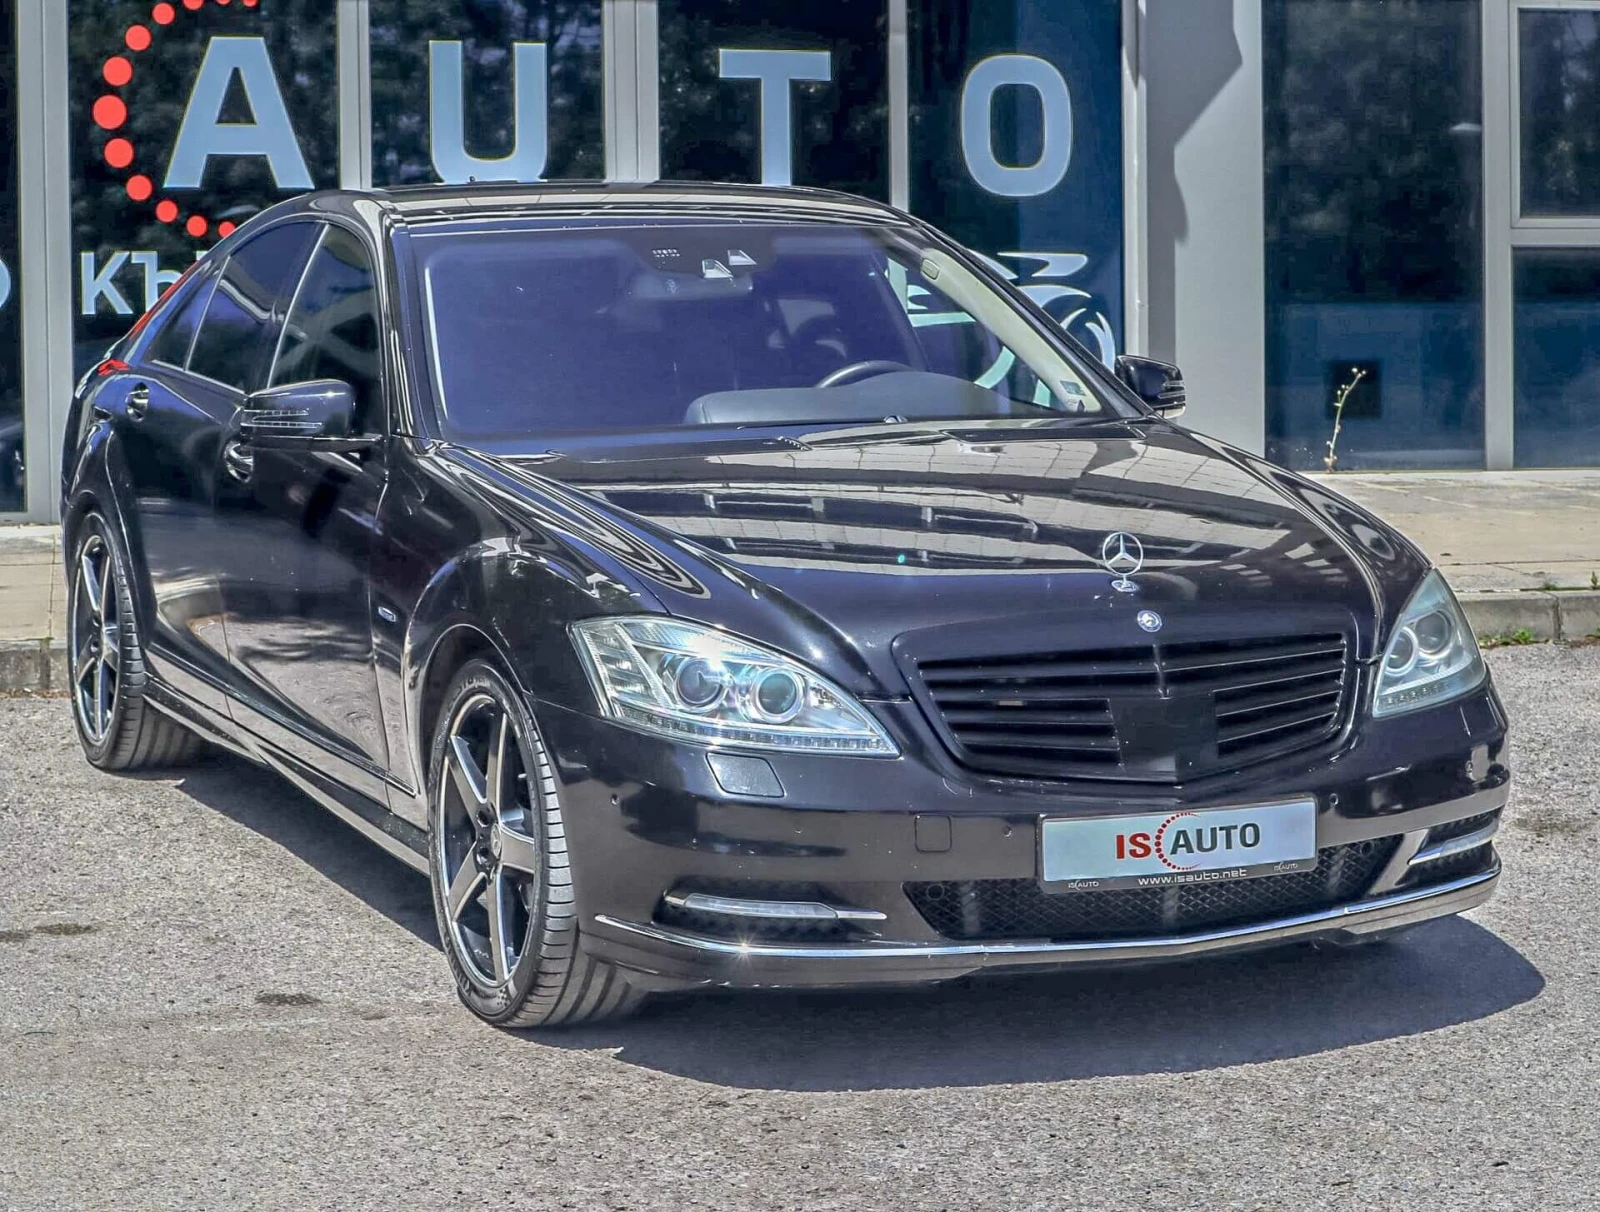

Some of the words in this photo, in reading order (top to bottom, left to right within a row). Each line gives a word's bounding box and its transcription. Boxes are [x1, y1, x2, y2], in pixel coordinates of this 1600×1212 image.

[163, 36, 1072, 197] AUTO
[1115, 832, 1151, 859] IS
[1169, 822, 1261, 856] AUTO
[1138, 868, 1247, 886] www.isauto.net
